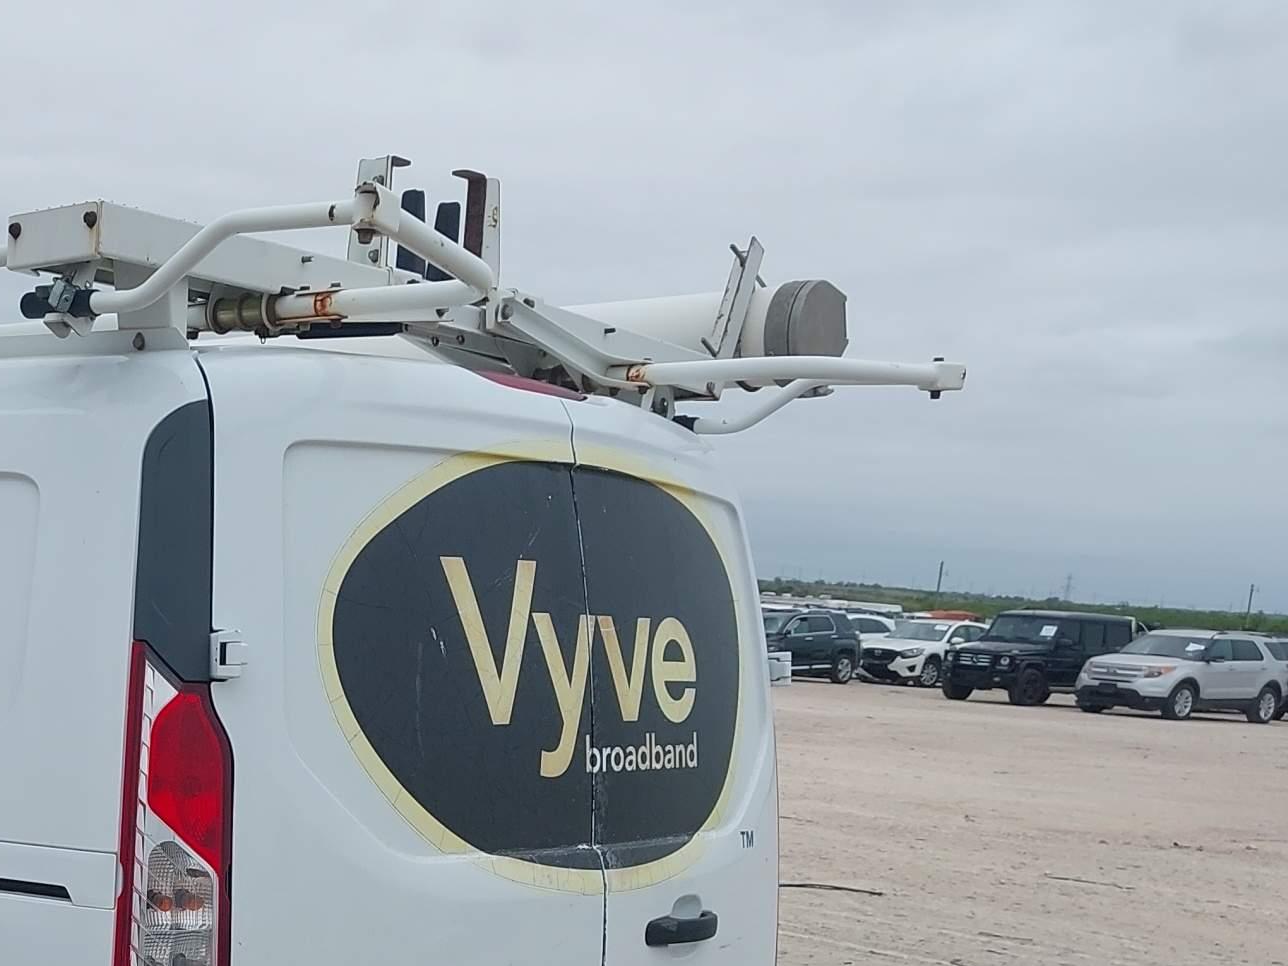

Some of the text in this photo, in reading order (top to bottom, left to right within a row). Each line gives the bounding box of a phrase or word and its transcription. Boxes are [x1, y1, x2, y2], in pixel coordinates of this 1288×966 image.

[439, 556, 697, 778] Vyve
[585, 731, 698, 774] broadband
[740, 831, 754, 848] TM
